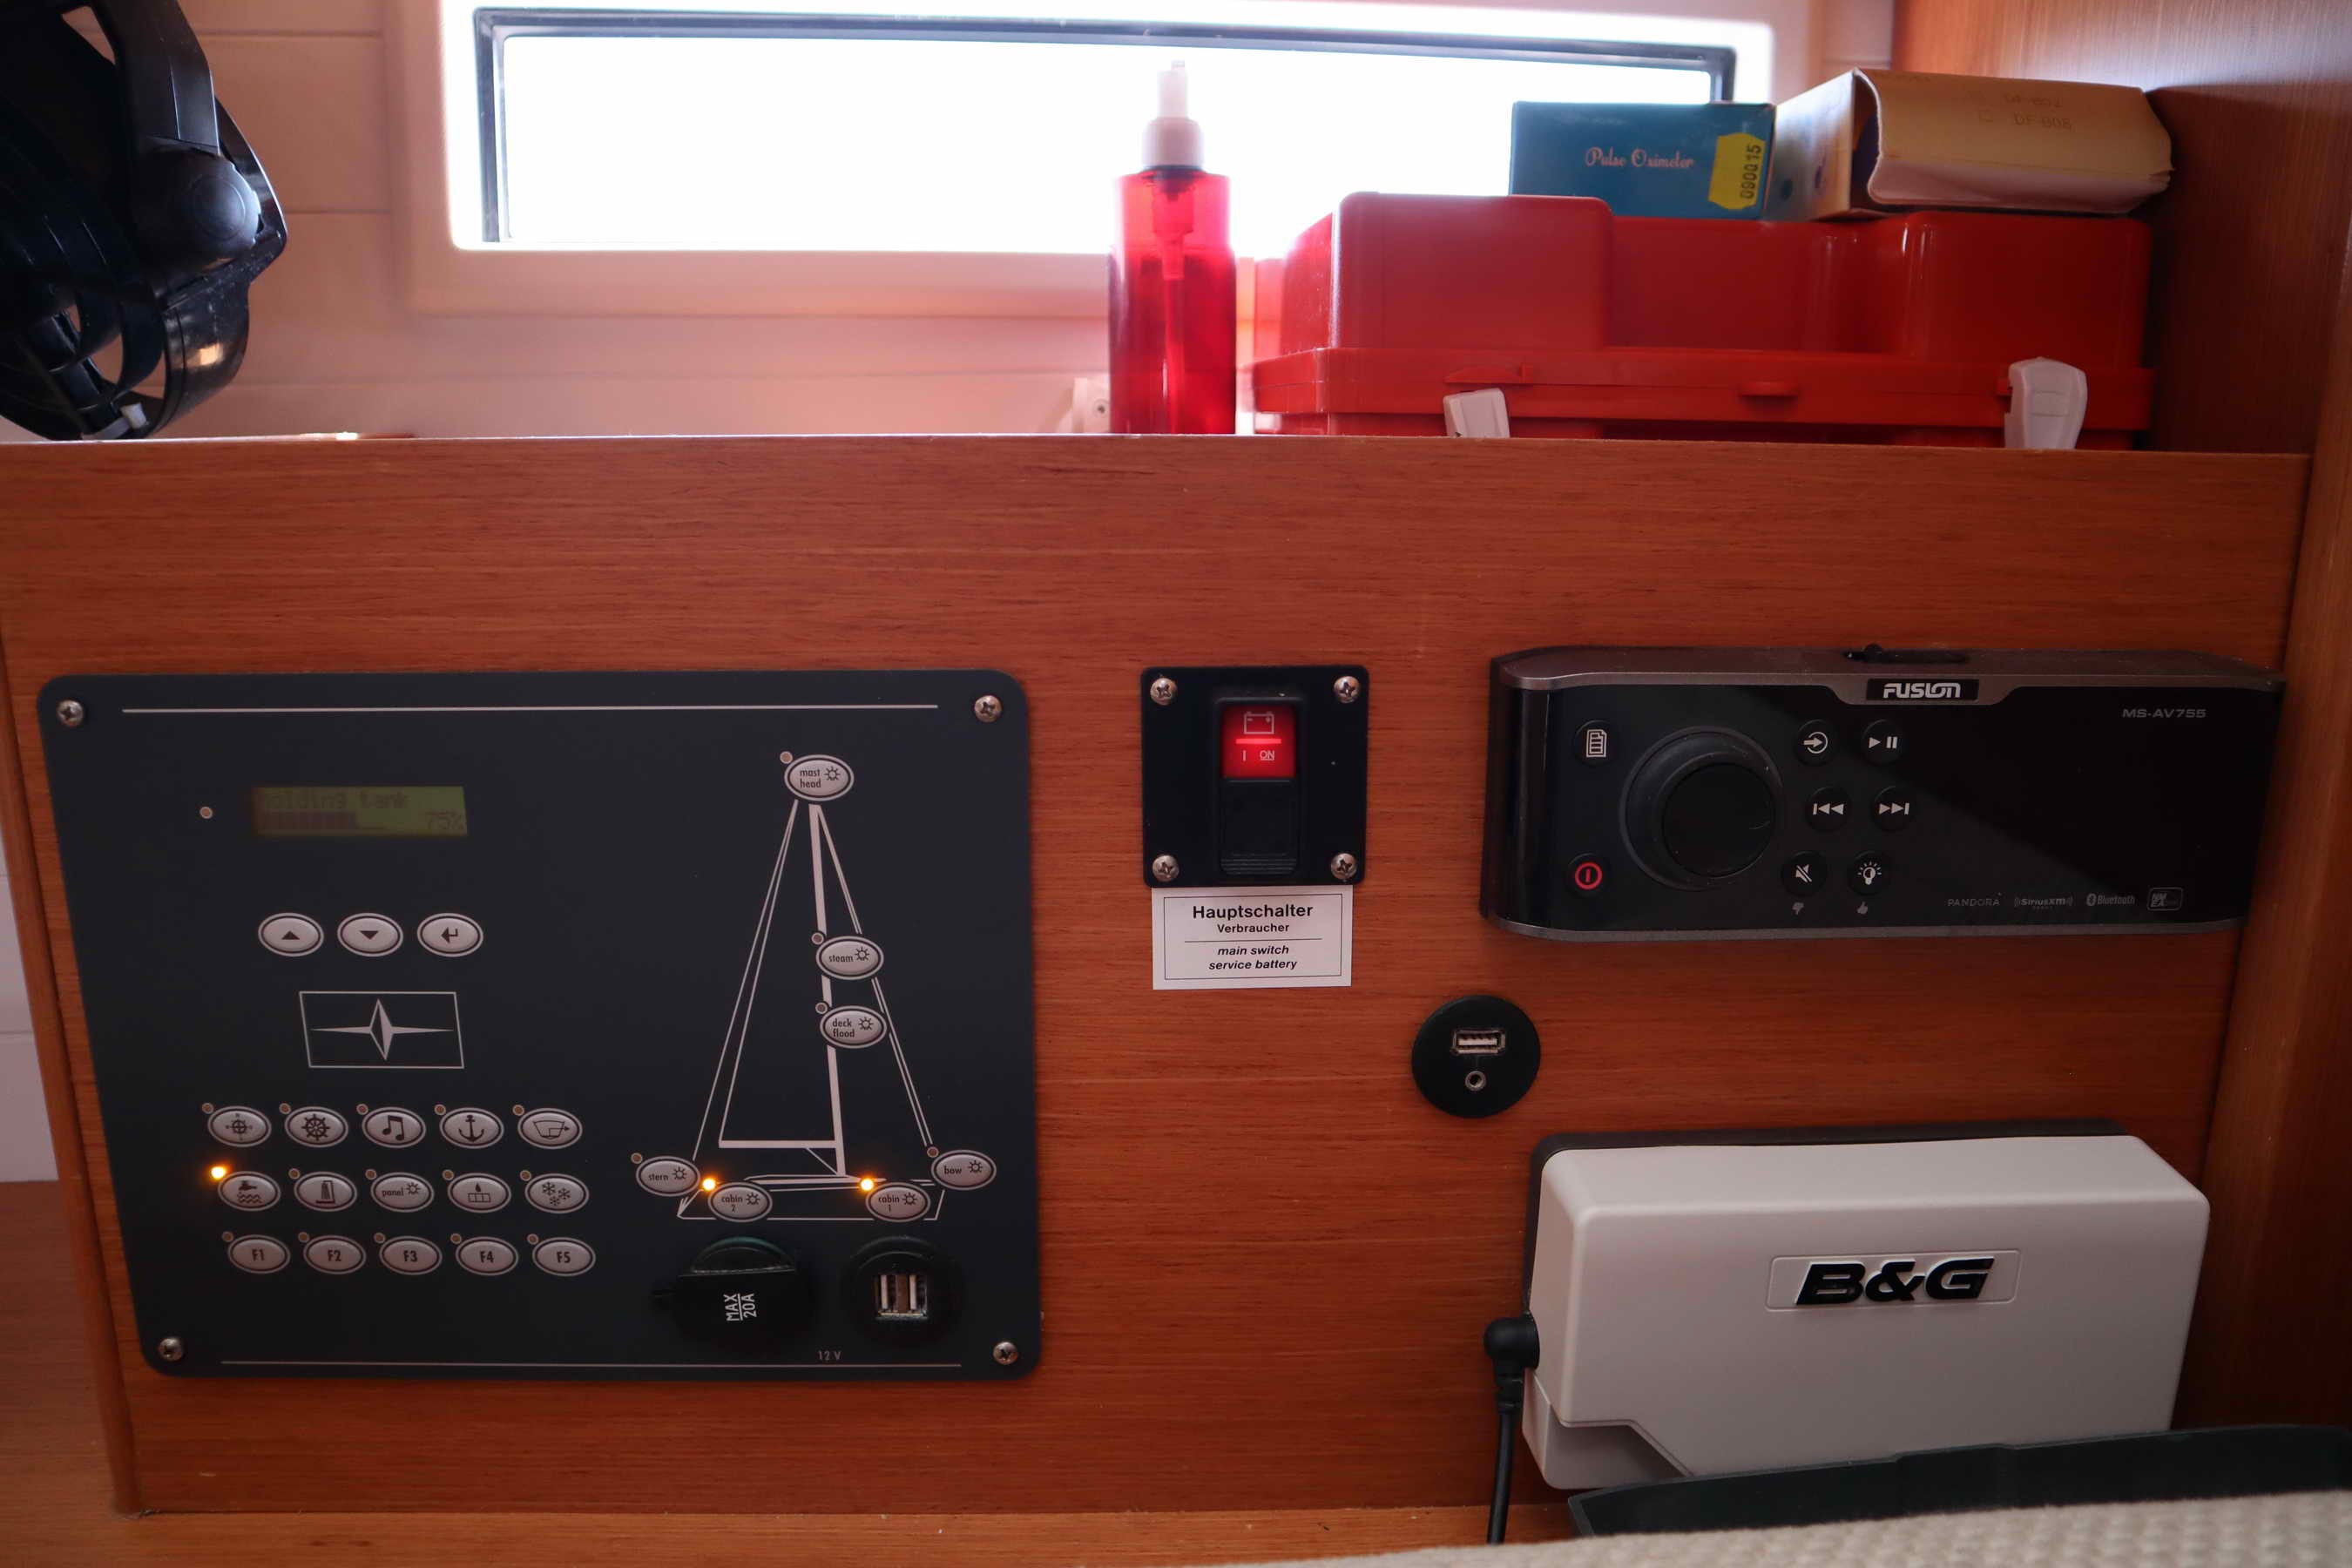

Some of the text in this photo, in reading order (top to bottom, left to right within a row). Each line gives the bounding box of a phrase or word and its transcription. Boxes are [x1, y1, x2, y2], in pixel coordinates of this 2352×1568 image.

[1585, 146, 1694, 169] Pulse Oximeter
[1882, 682, 1962, 700] FUSION
[2121, 708, 2207, 719] MS-AV755
[1259, 749, 1275, 761] ON
[799, 768, 821, 778] mast
[799, 779, 821, 789] head
[1947, 898, 2001, 907] PANDORA
[2096, 893, 2137, 906] Bluetooth
[1193, 904, 1314, 921] Hauptschalter
[1217, 923, 1290, 934] Verbraucher
[1217, 943, 1290, 956] main switch
[828, 953, 854, 963] steam
[1208, 958, 1298, 971] service battery
[832, 1017, 853, 1028] deck
[832, 1028, 855, 1038] flood
[943, 1165, 963, 1175] bow
[647, 1172, 669, 1182] stern
[382, 1187, 405, 1199] panel
[721, 1193, 743, 1204] cabin
[878, 1193, 901, 1204] cabin
[252, 1248, 266, 1261] F1
[328, 1249, 341, 1262] F2
[403, 1250, 418, 1262] F3
[480, 1250, 495, 1263] F4
[557, 1251, 571, 1263] F5
[1795, 1256, 1995, 1306] B&G
[723, 1293, 740, 1322] MAX
[742, 1292, 757, 1319] 20A
[817, 1350, 842, 1361] 12 V
